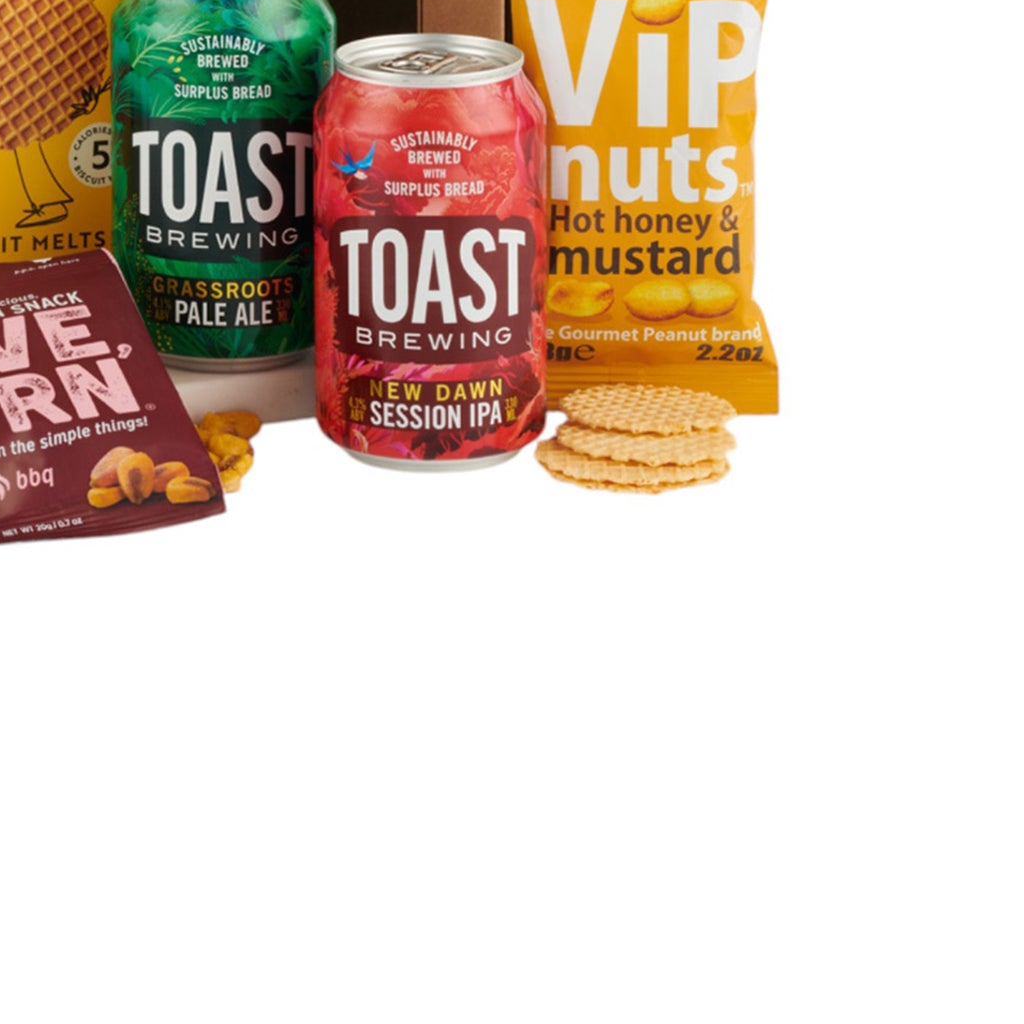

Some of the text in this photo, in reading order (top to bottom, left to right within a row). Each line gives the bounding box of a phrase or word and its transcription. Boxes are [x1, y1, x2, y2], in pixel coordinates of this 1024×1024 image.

[180, 35, 265, 56] SUSTAINABLY
[197, 54, 249, 68] BREWED
[212, 72, 234, 82] WITH
[174, 84, 272, 100] SURPLUS BREAD
[73, 126, 112, 150] CALORIES
[390, 131, 478, 152] SUSTAINABLY
[408, 150, 461, 164] BREWED
[550, 133, 738, 203] nuts
[132, 130, 313, 224] TOAST
[423, 168, 446, 178] WITH
[384, 181, 484, 197] SURPLUS BREAD
[550, 204, 738, 240] Hot honey &
[32, 231, 106, 251] MELTS
[146, 225, 299, 250] BREWING
[548, 233, 741, 275] mustard
[152, 276, 294, 299] GRASSROOTS
[339, 228, 526, 324] TOAST
[10, 291, 83, 314] SNACK
[175, 300, 227, 326] PALE
[234, 300, 273, 326] ALE
[356, 326, 512, 350] BREWING
[559, 325, 638, 341] Gourmet
[643, 327, 708, 342] Peanut
[712, 322, 762, 342] brand
[695, 344, 764, 361] 2.2oz
[369, 378, 502, 401] NEW DAWN
[370, 400, 461, 430] SESSION
[470, 400, 502, 427] IPA
[10, 440, 35, 456] the
[40, 424, 91, 451] simple
[94, 416, 148, 436] things!
[15, 467, 54, 491] bbq
